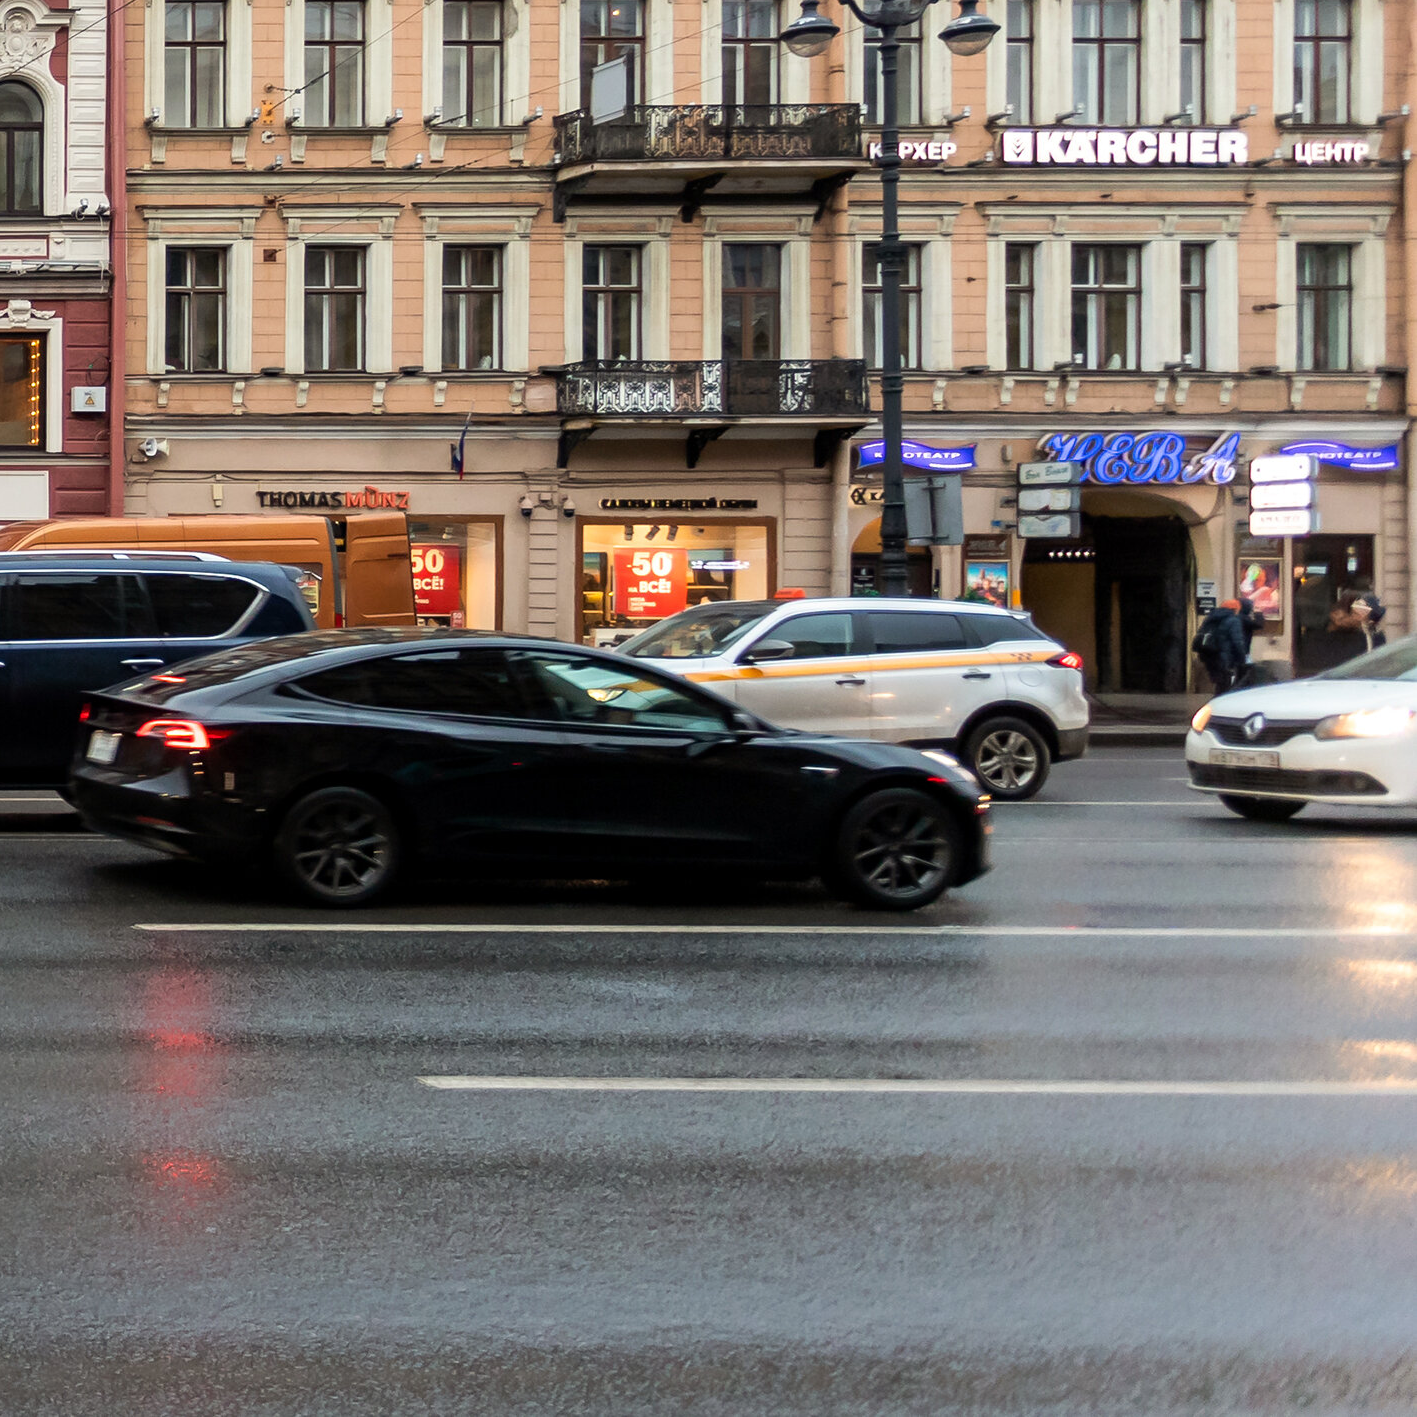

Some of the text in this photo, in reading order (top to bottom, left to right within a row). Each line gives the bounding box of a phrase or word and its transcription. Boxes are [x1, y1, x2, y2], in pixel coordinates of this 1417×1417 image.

[869, 141, 957, 160] КРХЕР
[1036, 130, 1248, 163] KÄRCHER
[1294, 141, 1369, 165] ЦЕНТР
[256, 491, 343, 507] THOMAS
[413, 576, 444, 590] ВСЁ!
